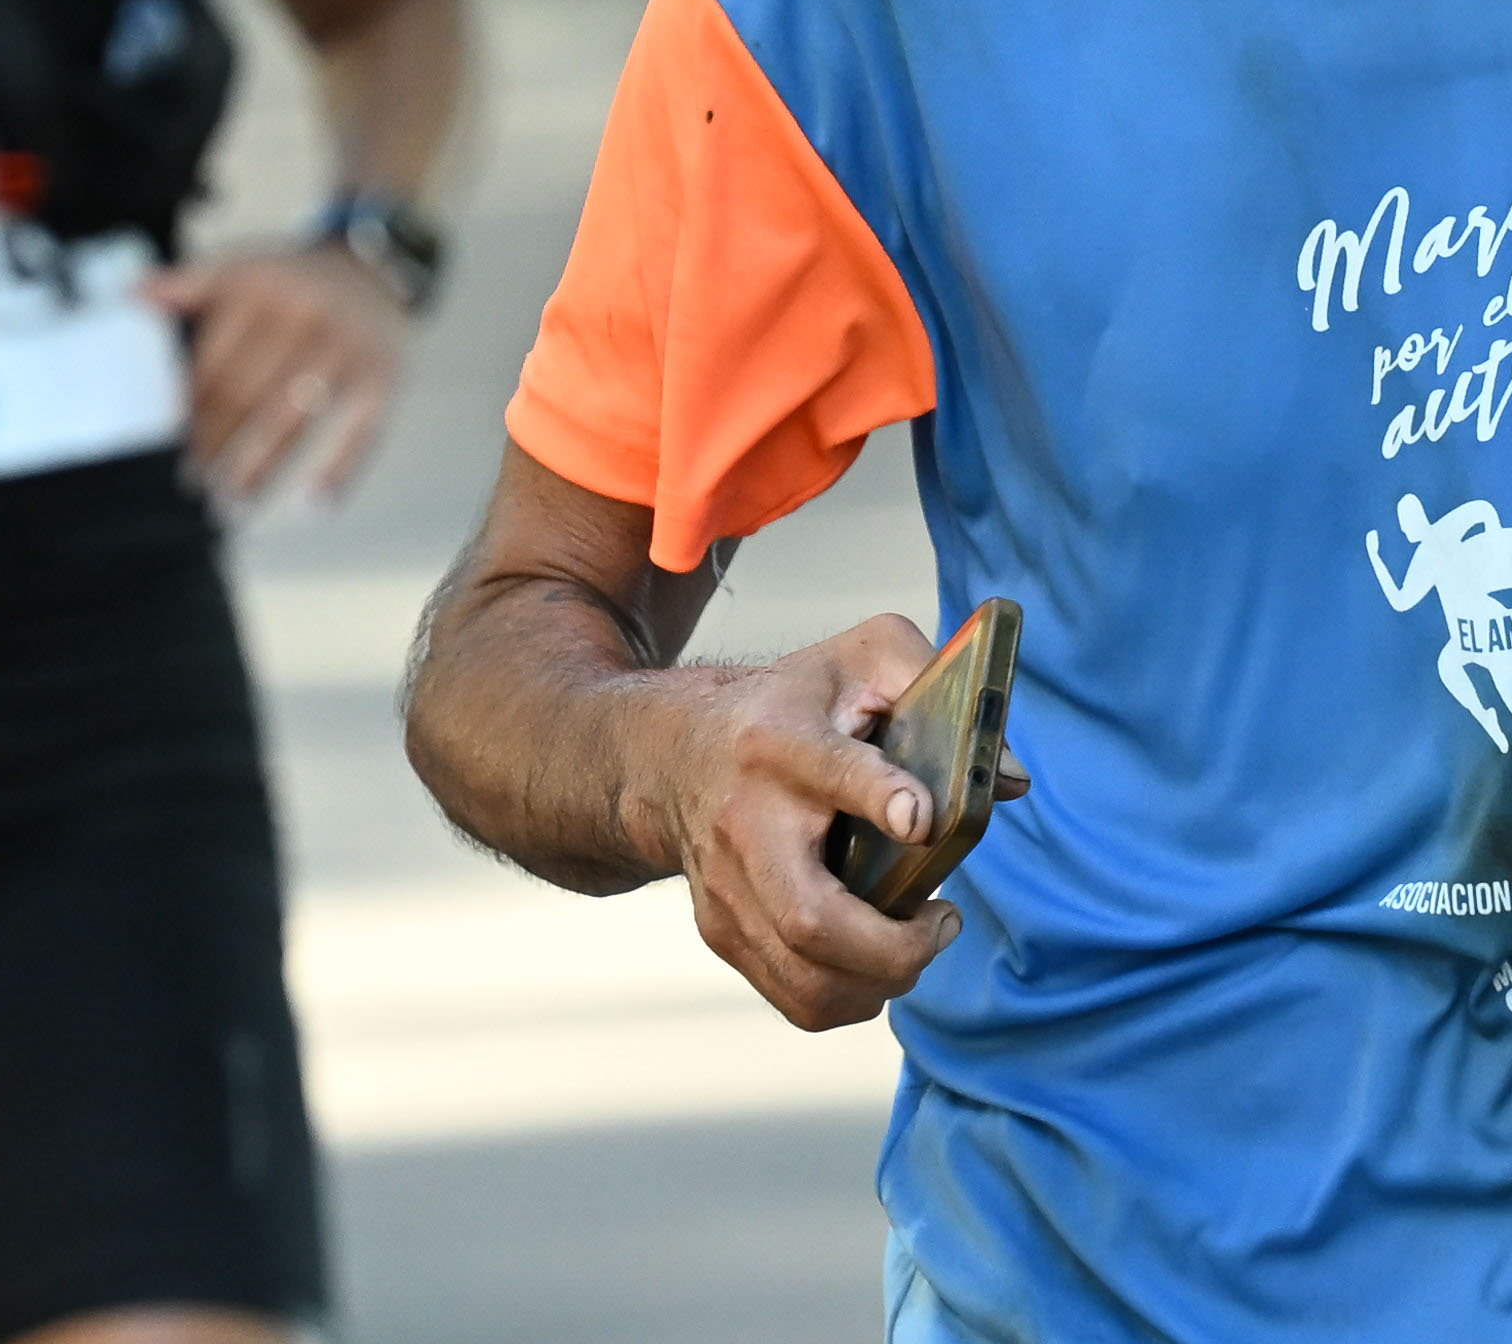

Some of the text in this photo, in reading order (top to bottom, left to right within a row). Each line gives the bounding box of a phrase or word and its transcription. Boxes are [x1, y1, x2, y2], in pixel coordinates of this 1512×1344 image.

[1371, 325, 1463, 404] por
[1457, 618, 1483, 653] EL
[1379, 880, 1512, 916] ASOCIACION
